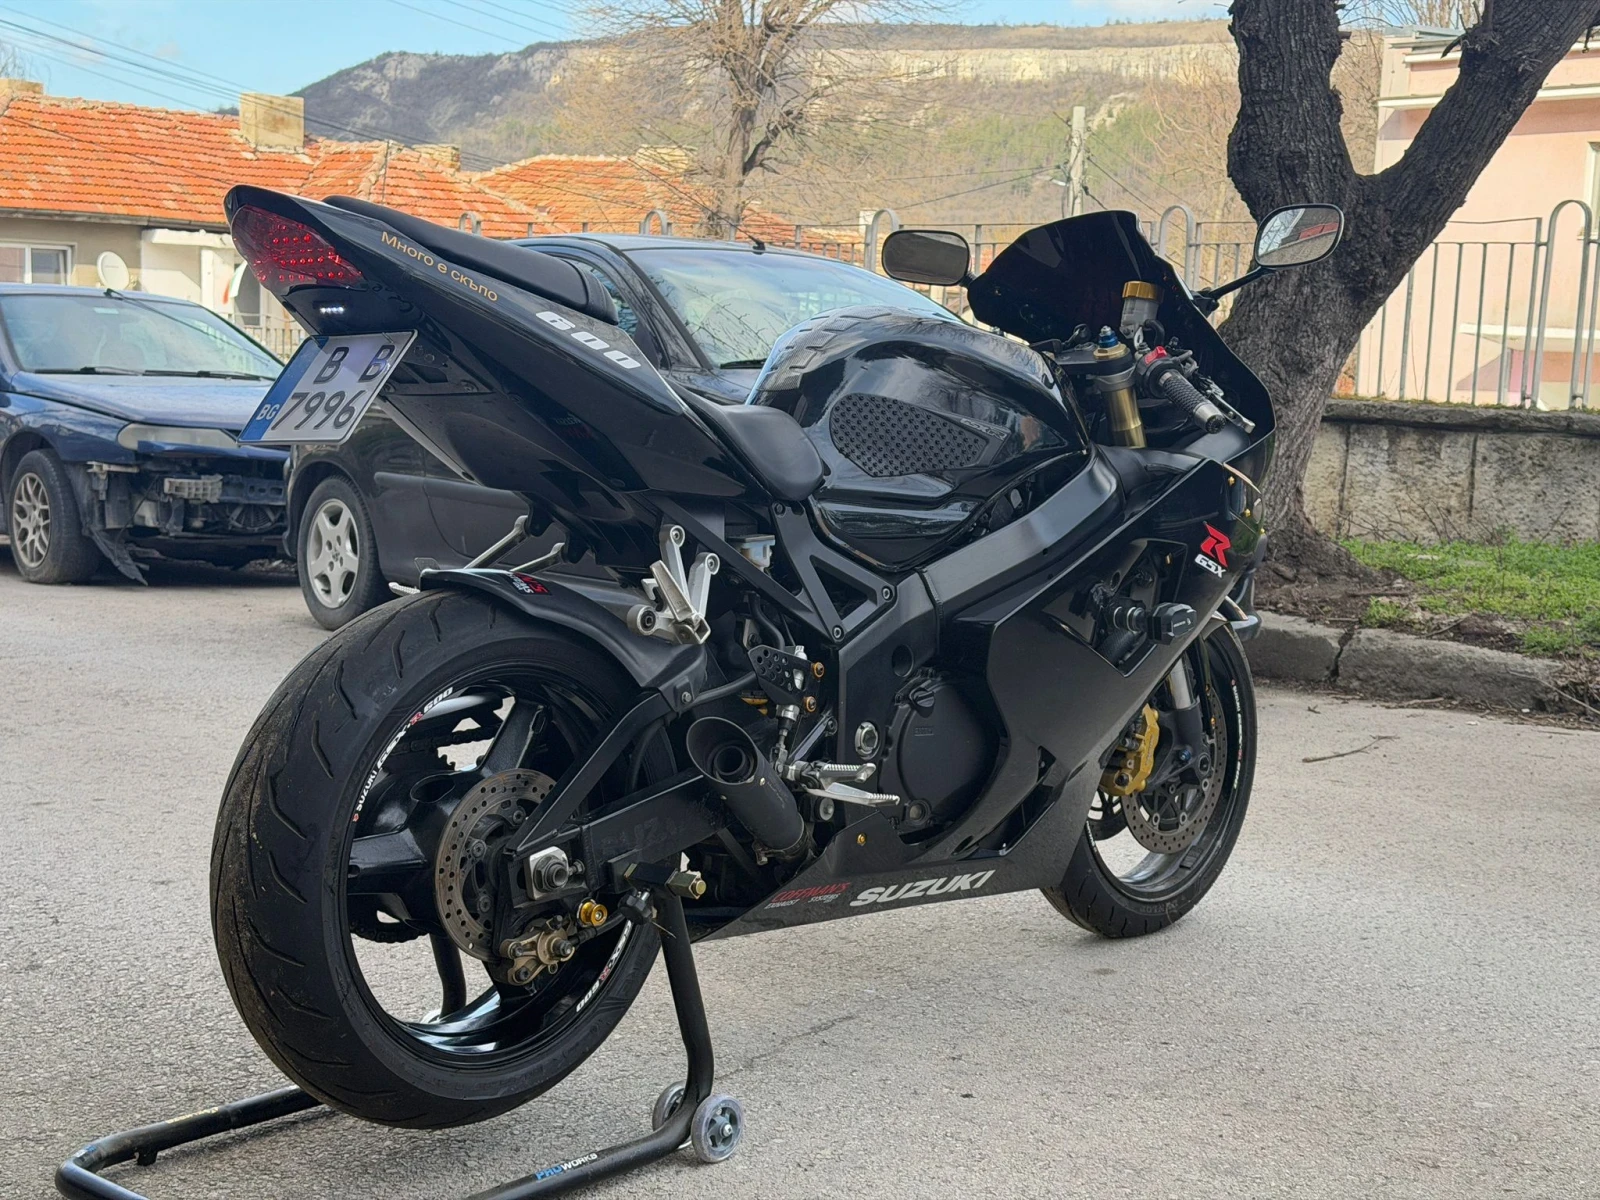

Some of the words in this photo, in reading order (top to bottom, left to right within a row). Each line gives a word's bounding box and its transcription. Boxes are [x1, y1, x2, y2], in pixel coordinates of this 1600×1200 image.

[381, 231, 434, 267] Много
[437, 262, 448, 274] е
[450, 269, 498, 302] скъпо
[536, 311, 641, 369] 600
[313, 346, 349, 384] B
[358, 344, 396, 383] B
[256, 404, 280, 421] BG
[271, 390, 366, 431] 7996
[1194, 553, 1227, 578] GSX
[356, 770, 378, 812] SUZUKI
[423, 686, 453, 713] 600
[850, 870, 996, 907] SUZUKI
[576, 979, 600, 1012] 600
